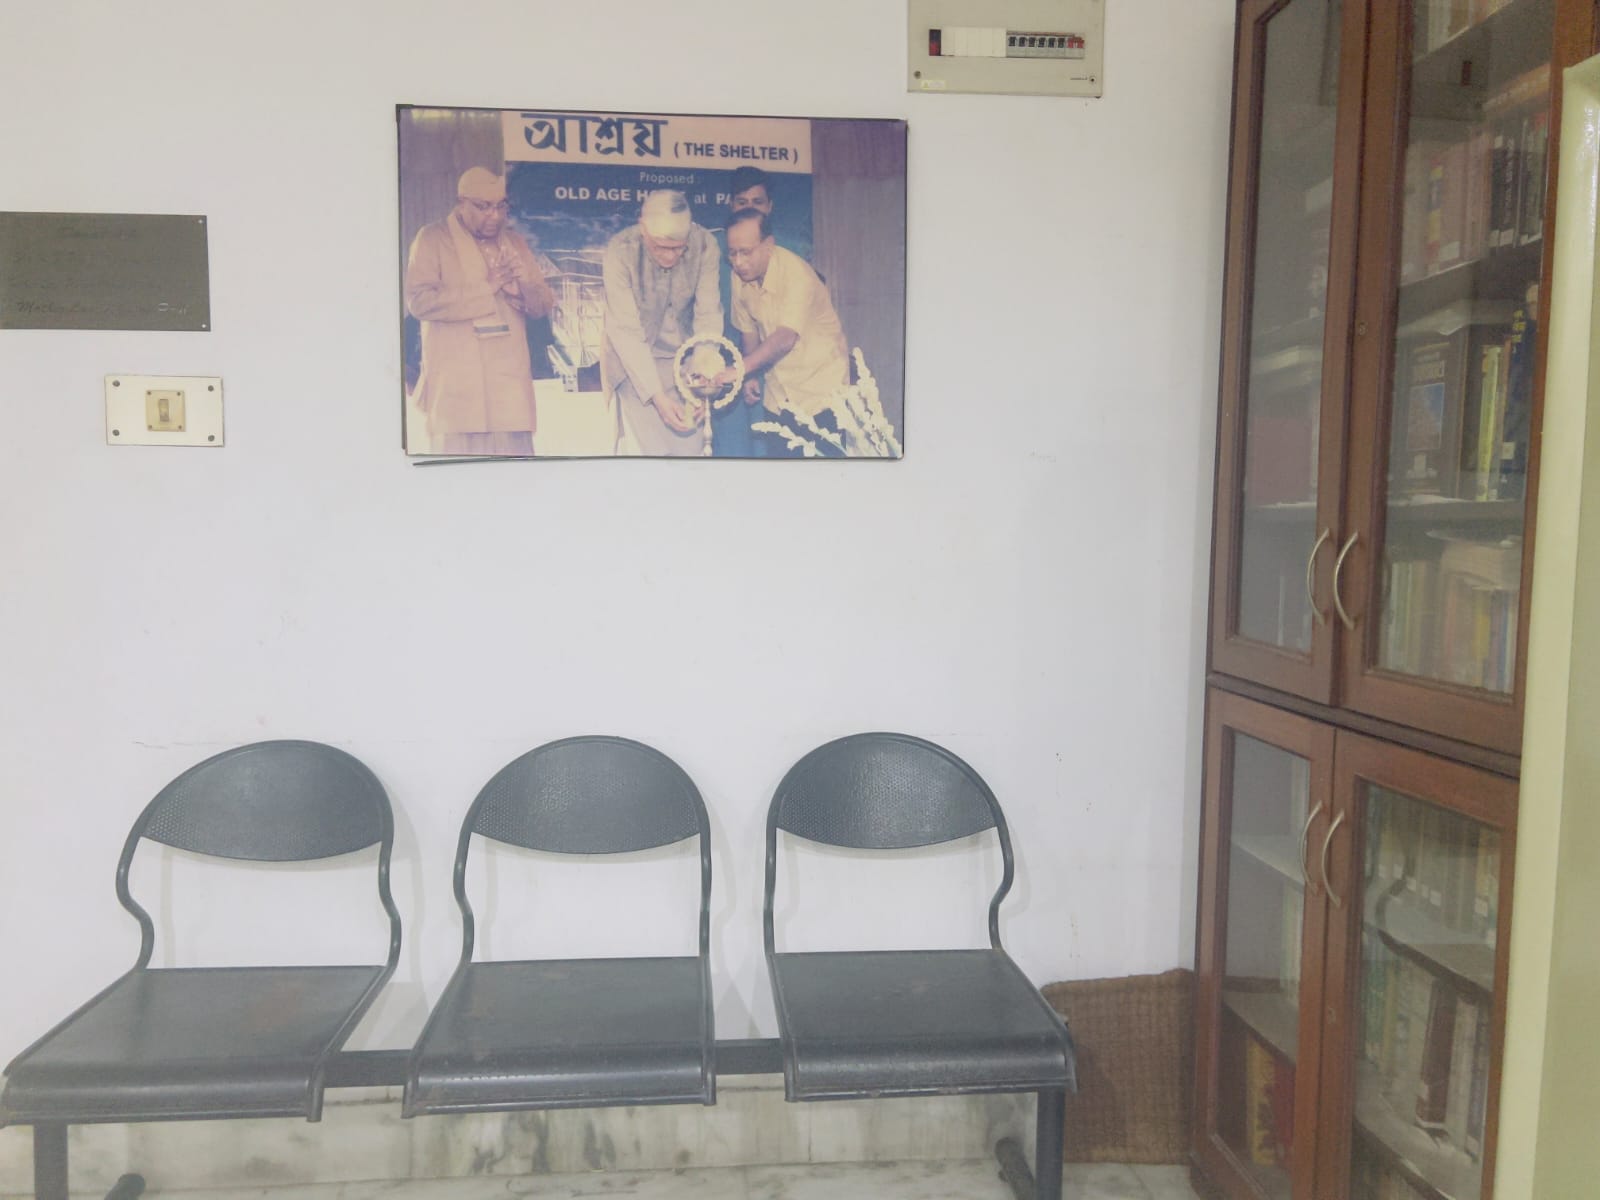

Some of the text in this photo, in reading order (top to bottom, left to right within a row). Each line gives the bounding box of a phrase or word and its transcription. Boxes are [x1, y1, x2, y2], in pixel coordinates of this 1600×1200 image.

[520, 112, 669, 158] আশ্রয়
[639, 171, 695, 185] Proposed
[554, 186, 590, 200] OLD
[595, 188, 631, 201] AGE
[693, 192, 707, 204] at
